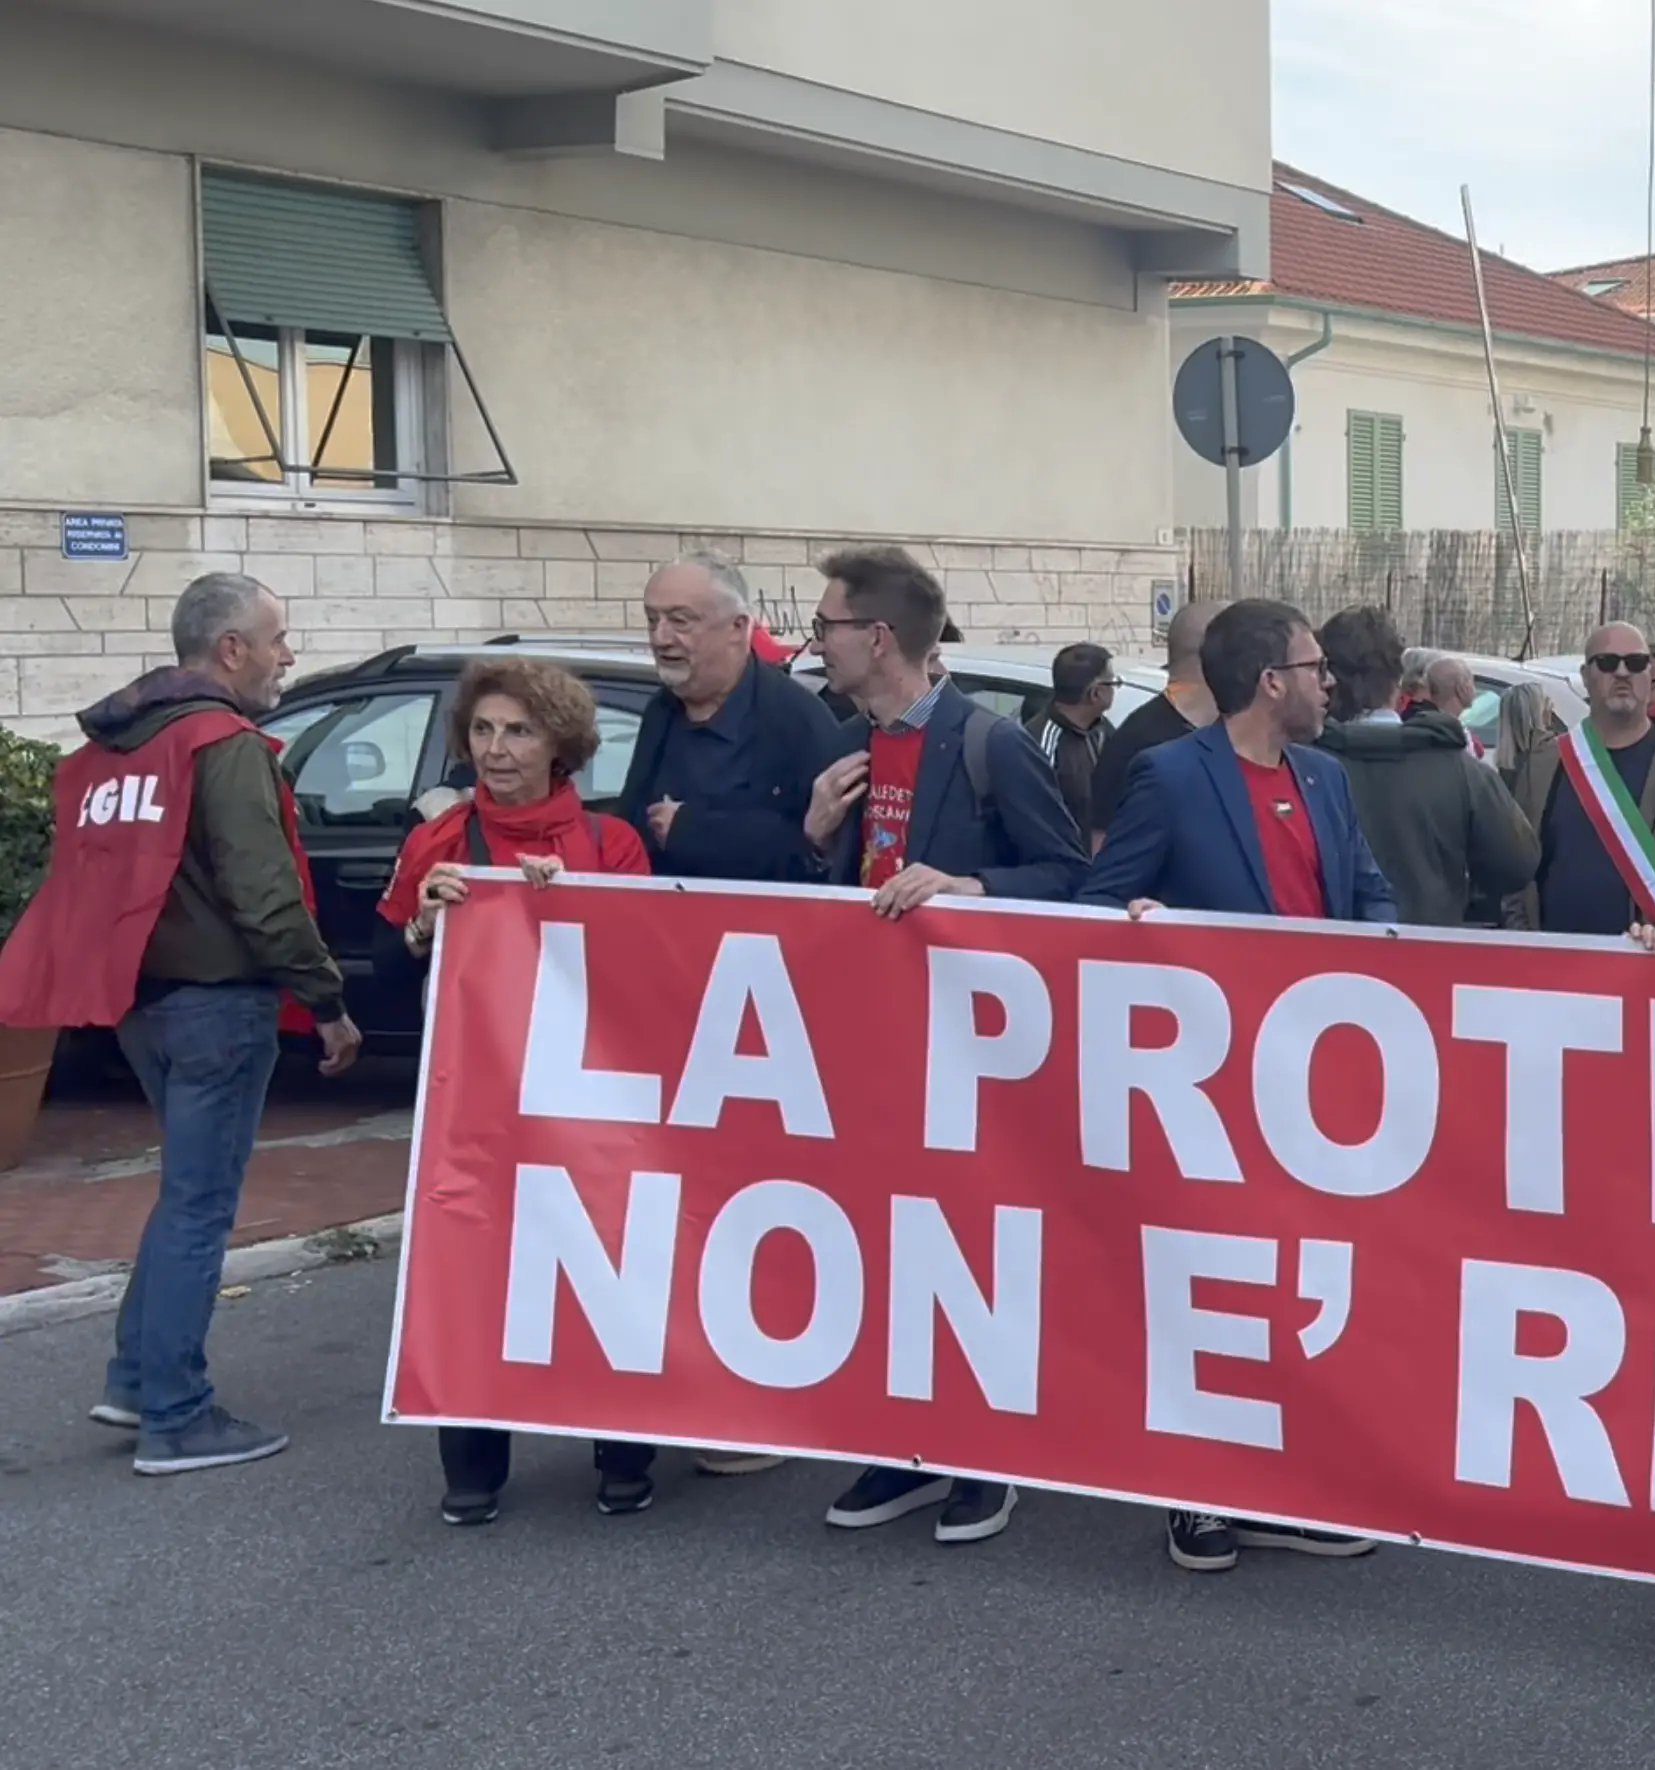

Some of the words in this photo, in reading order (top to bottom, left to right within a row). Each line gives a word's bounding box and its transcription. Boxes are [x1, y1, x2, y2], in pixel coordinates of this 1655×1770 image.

[519, 922, 834, 1138] LA
[503, 1164, 1042, 1414] NON
[1142, 1226, 1353, 1450] E'
